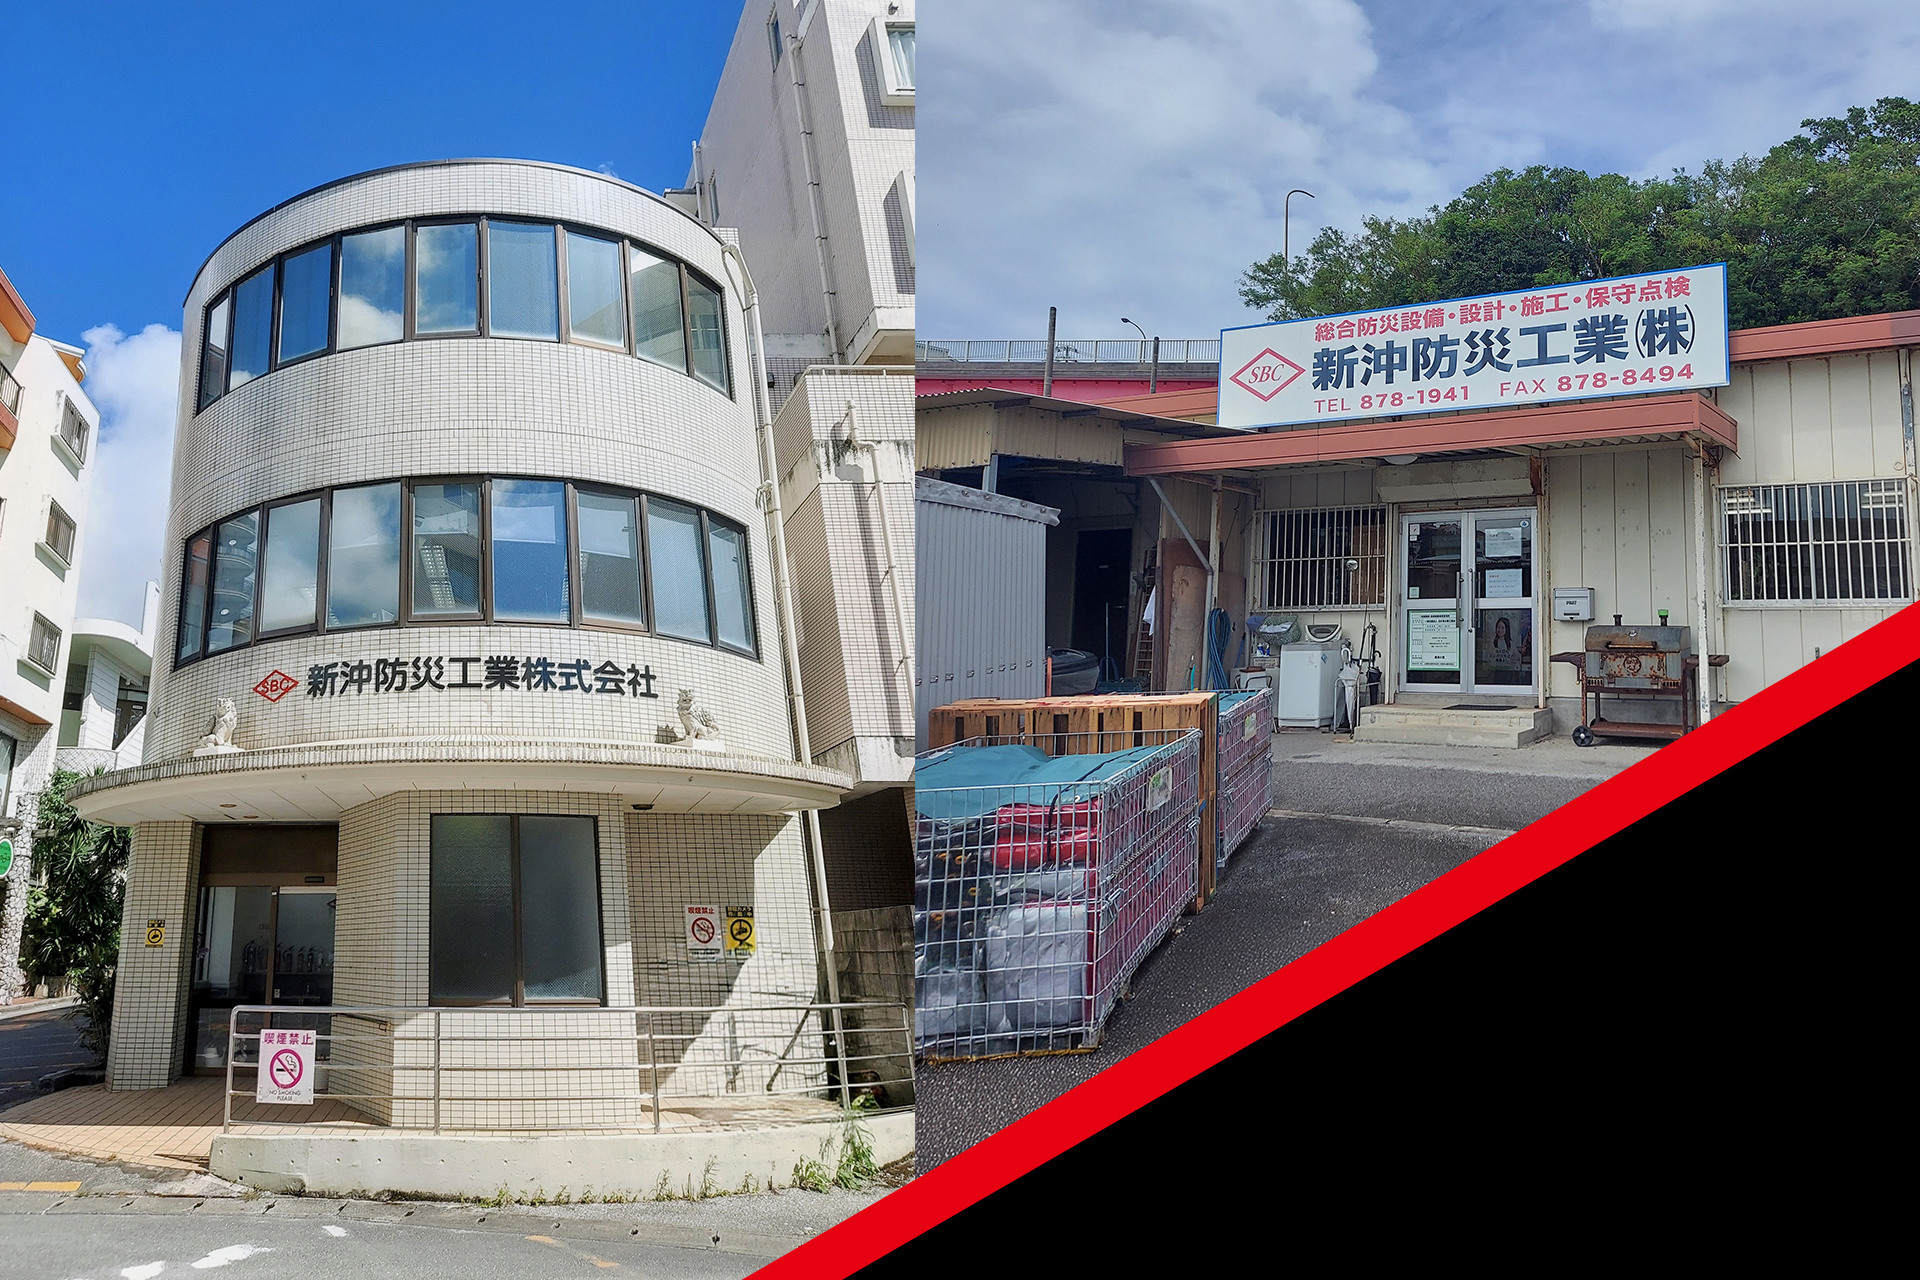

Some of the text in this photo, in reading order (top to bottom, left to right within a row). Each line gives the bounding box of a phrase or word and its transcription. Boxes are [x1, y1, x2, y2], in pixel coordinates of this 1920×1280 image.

[1315, 275, 1691, 343] 総合防災設備・設計・施工・保守点検
[1311, 303, 1696, 392] 新沖防災工業(株)
[1248, 364, 1284, 384] SBC
[1314, 363, 1694, 414] TEL 878-1941 FAX 878-8494
[260, 677, 290, 694] SBC
[306, 655, 659, 699] 新沖防災工業株式会社
[264, 1032, 314, 1045] 喫煙禁止
